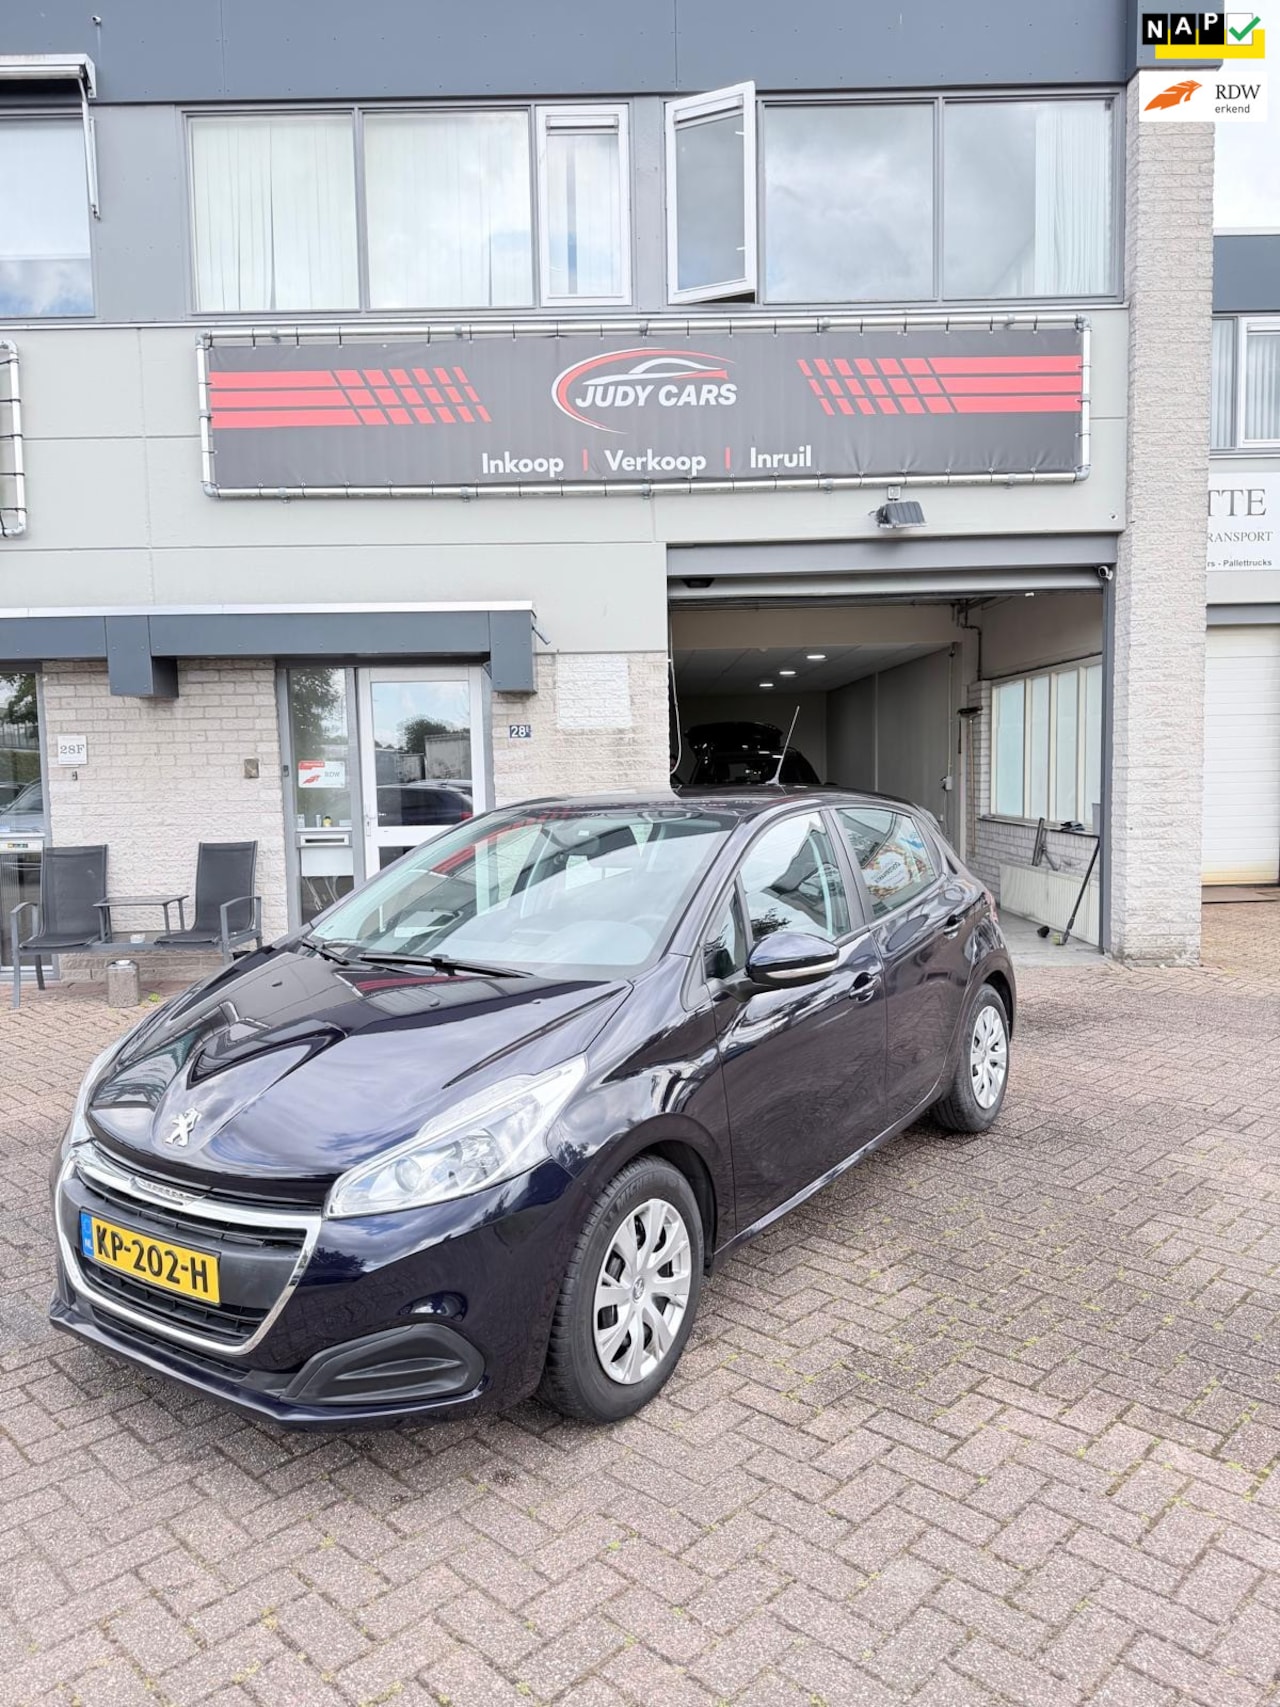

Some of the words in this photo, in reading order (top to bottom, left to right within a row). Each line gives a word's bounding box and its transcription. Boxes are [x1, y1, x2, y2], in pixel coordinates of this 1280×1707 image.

[575, 385, 655, 408] JUDY
[658, 383, 738, 406] CARS
[482, 451, 564, 478] Inkoop
[604, 448, 707, 476] Verkoop
[750, 445, 812, 469] Inruil
[1223, 558, 1272, 568] Pallettrucks
[60, 744, 85, 755] 28F
[96, 1224, 208, 1293] KP-202-H
